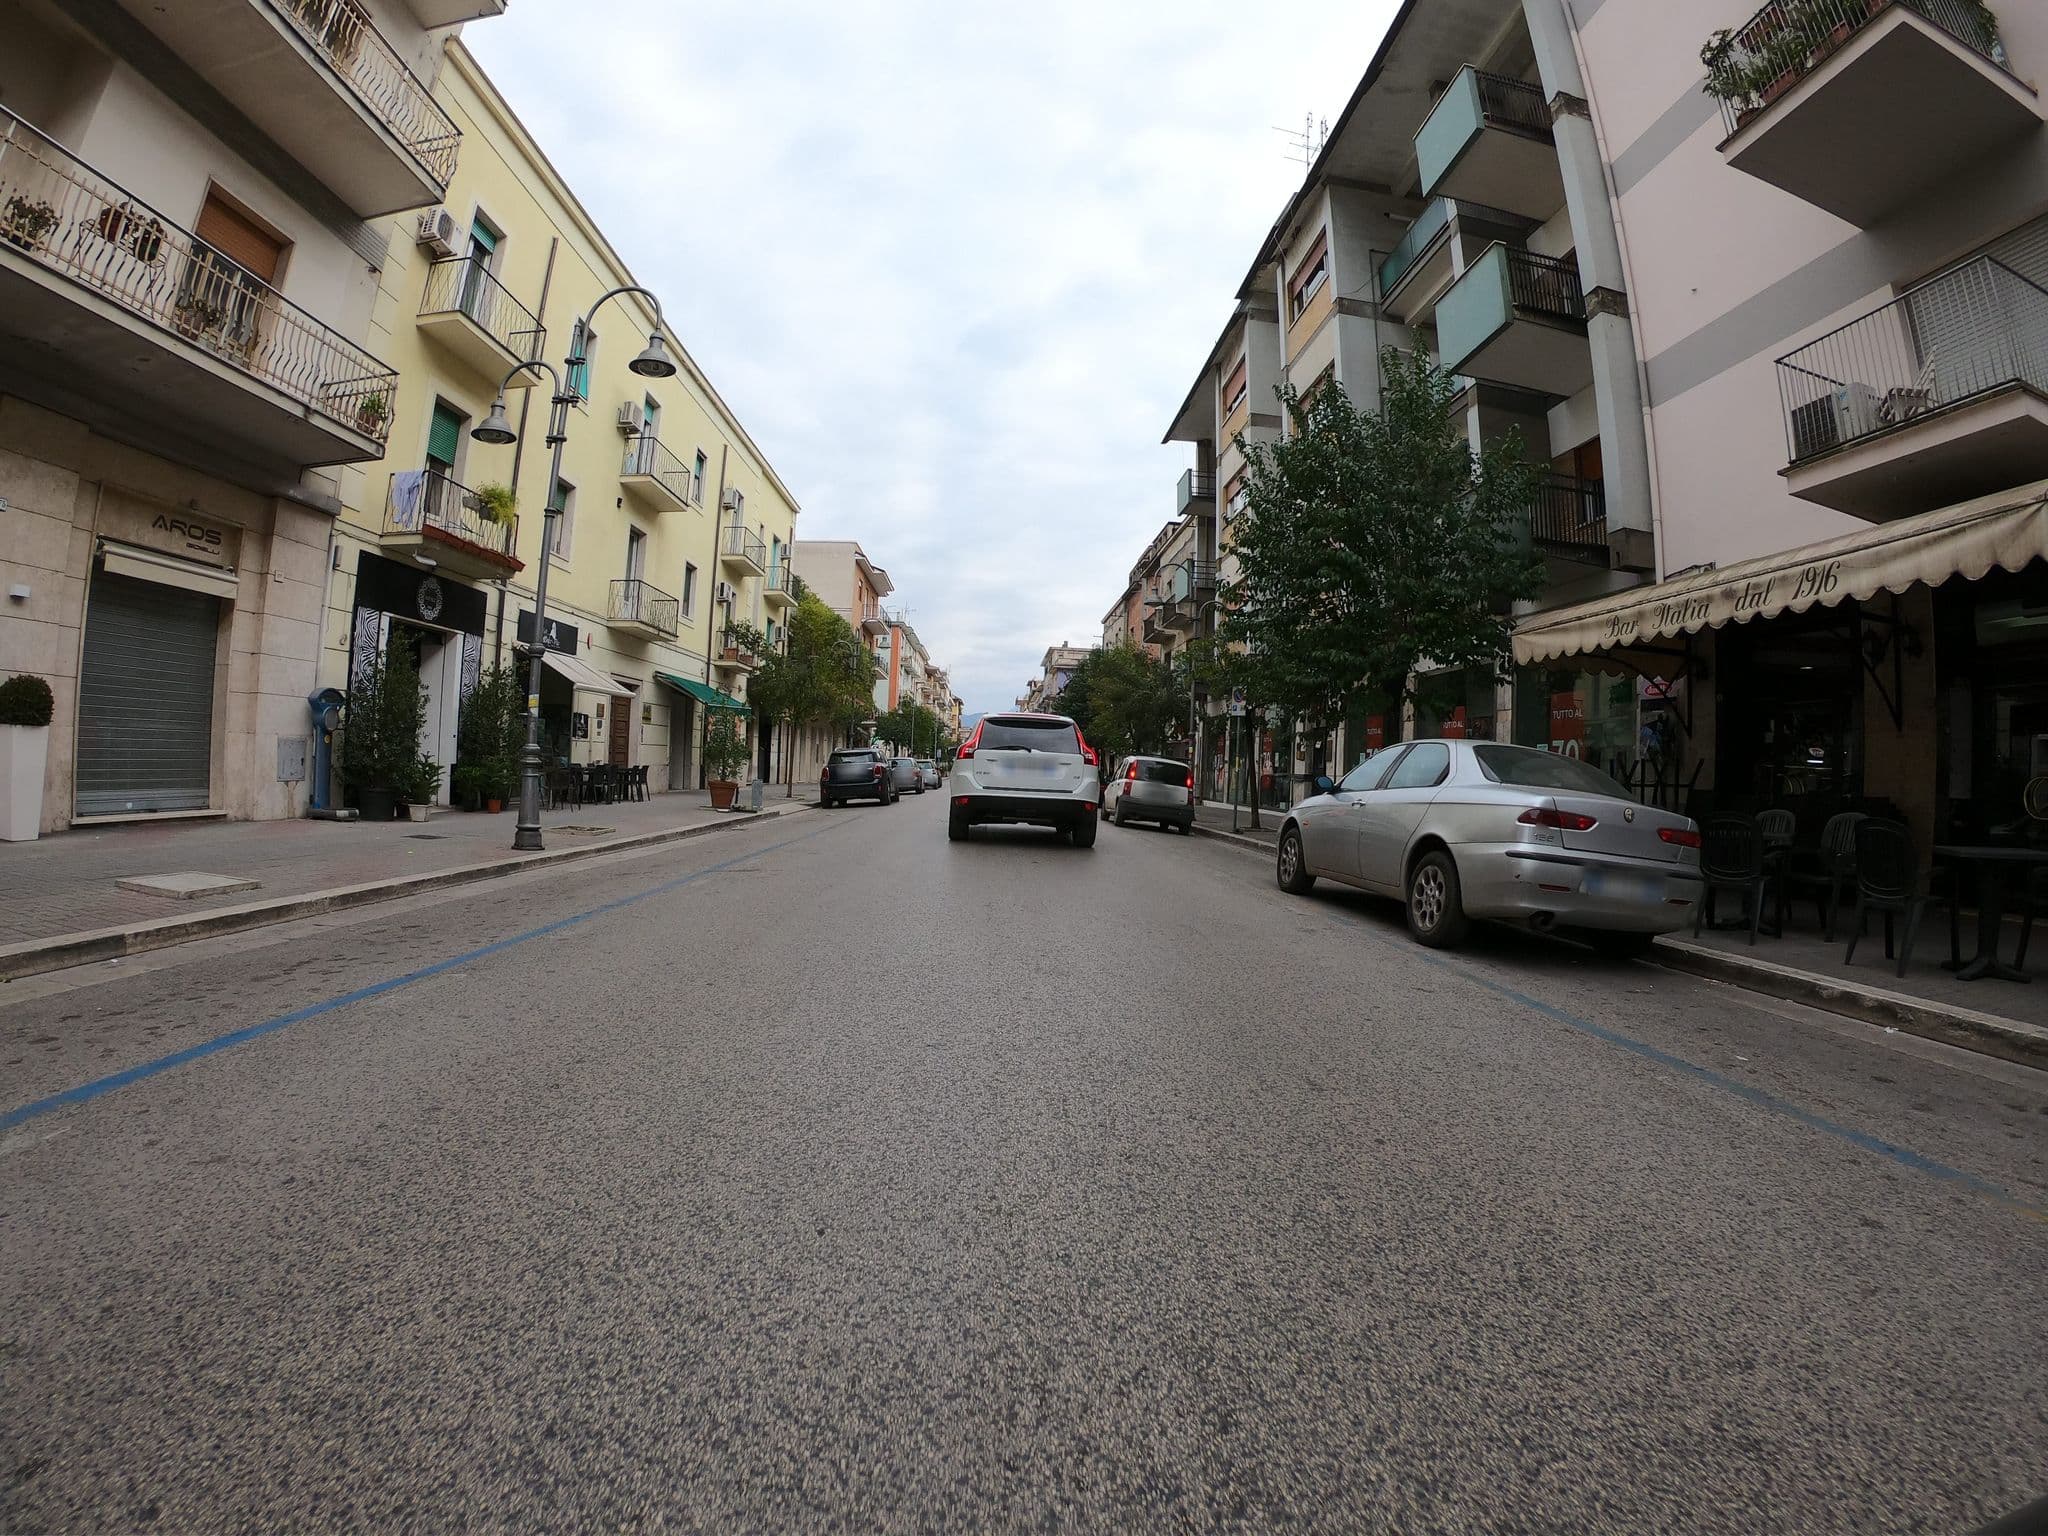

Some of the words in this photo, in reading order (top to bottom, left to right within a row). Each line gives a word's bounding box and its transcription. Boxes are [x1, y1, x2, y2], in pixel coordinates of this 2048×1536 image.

[152, 513, 222, 546] AROS
[1605, 614, 1640, 639] Bar
[1652, 597, 1711, 630] Italia
[1735, 576, 1776, 612] dal
[1792, 560, 1841, 600] 1916
[1553, 709, 1574, 720] TUTTO
[1574, 708, 1583, 718] AL
